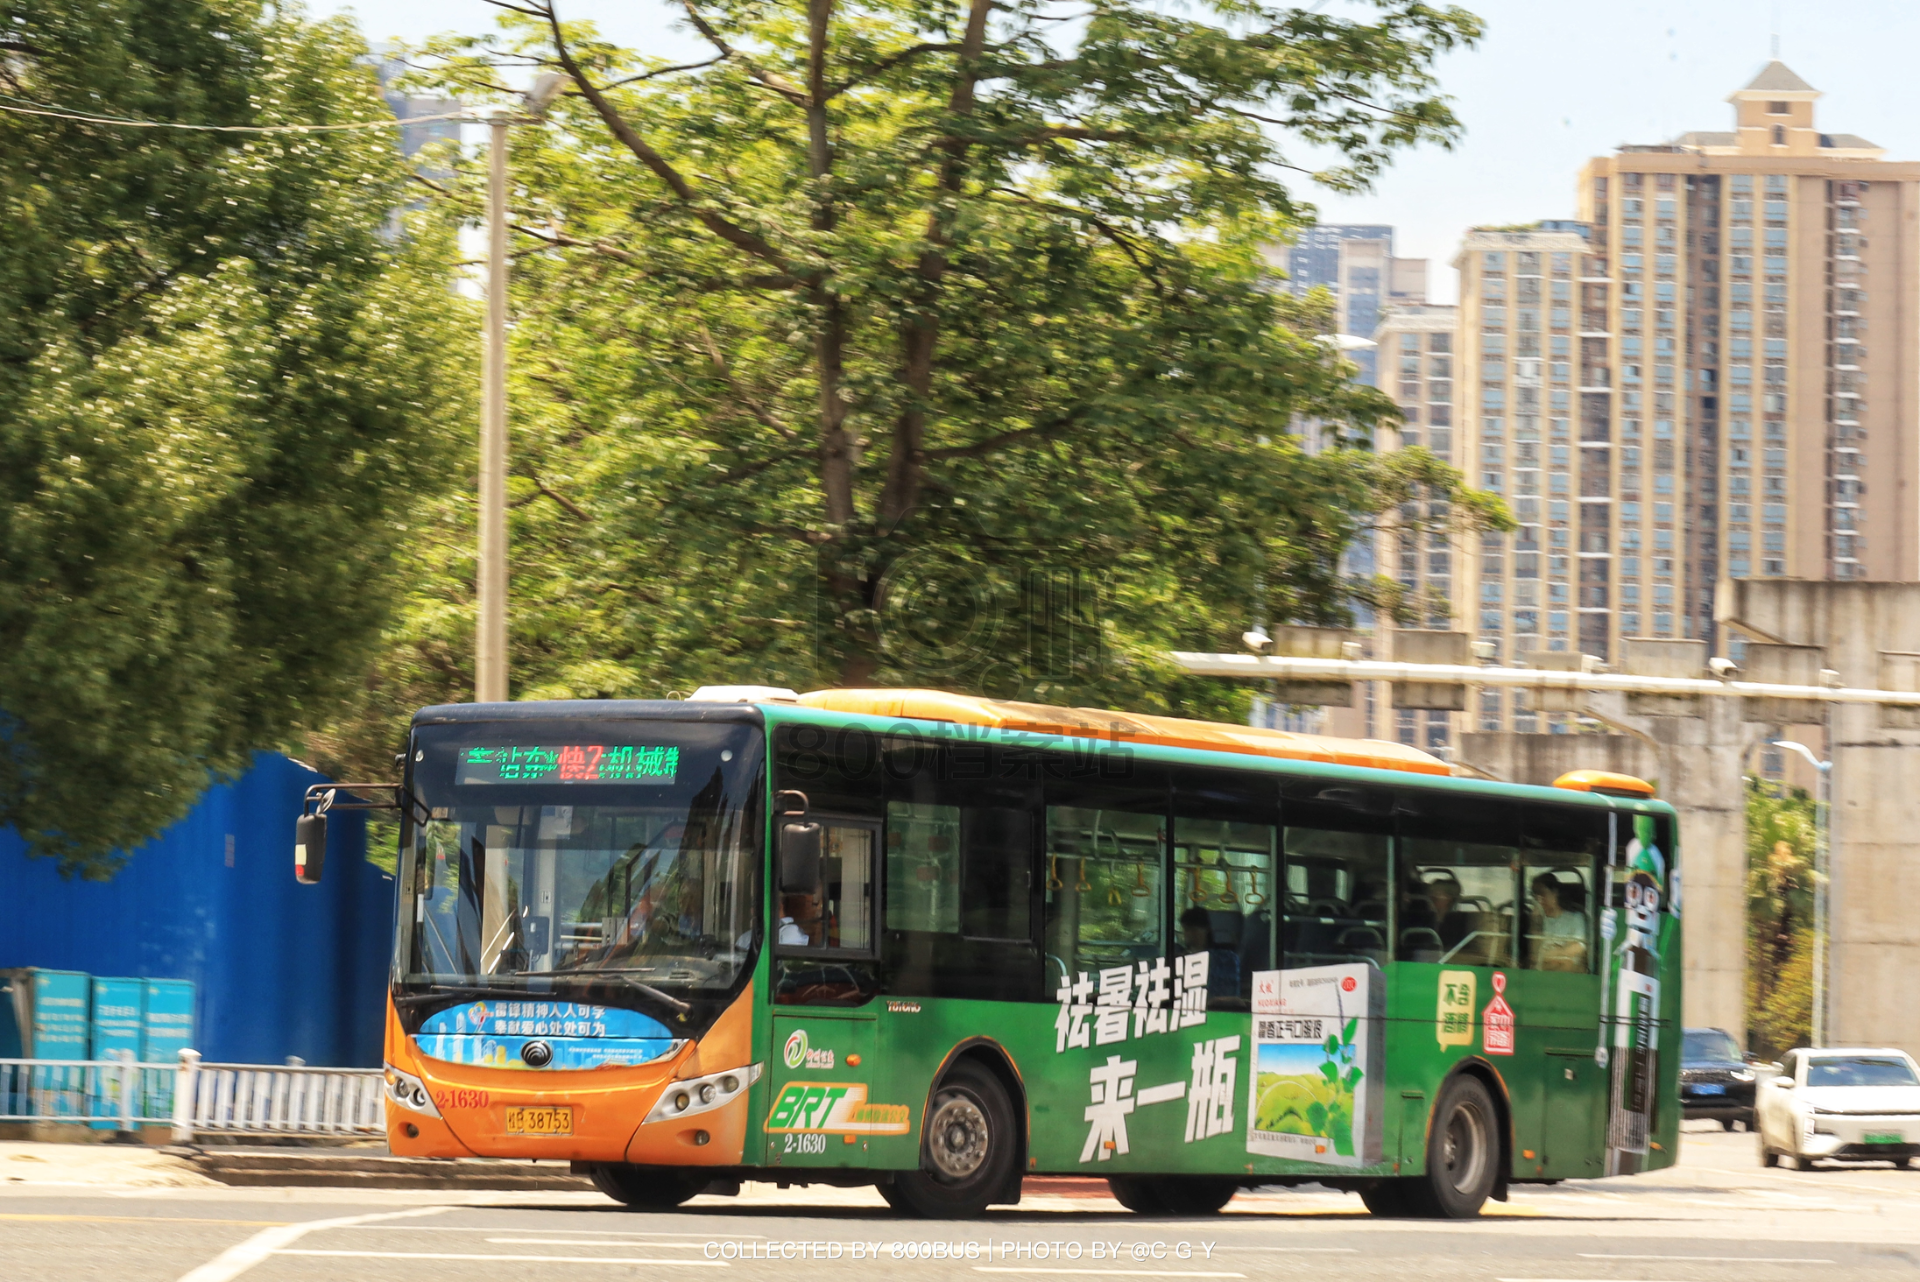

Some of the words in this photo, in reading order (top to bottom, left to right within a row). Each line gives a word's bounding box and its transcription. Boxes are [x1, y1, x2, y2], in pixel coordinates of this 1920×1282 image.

[495, 1002, 606, 1019] 雷锋精神人人可学
[1054, 951, 1209, 1053] 祛暑祛湿
[494, 1020, 606, 1037] 奉献爱心处处可为
[436, 1090, 489, 1109] 2-1630
[768, 1086, 849, 1129] BRT
[1079, 1035, 1240, 1163] 来一瓶
[784, 1133, 826, 1154] 2-1630
